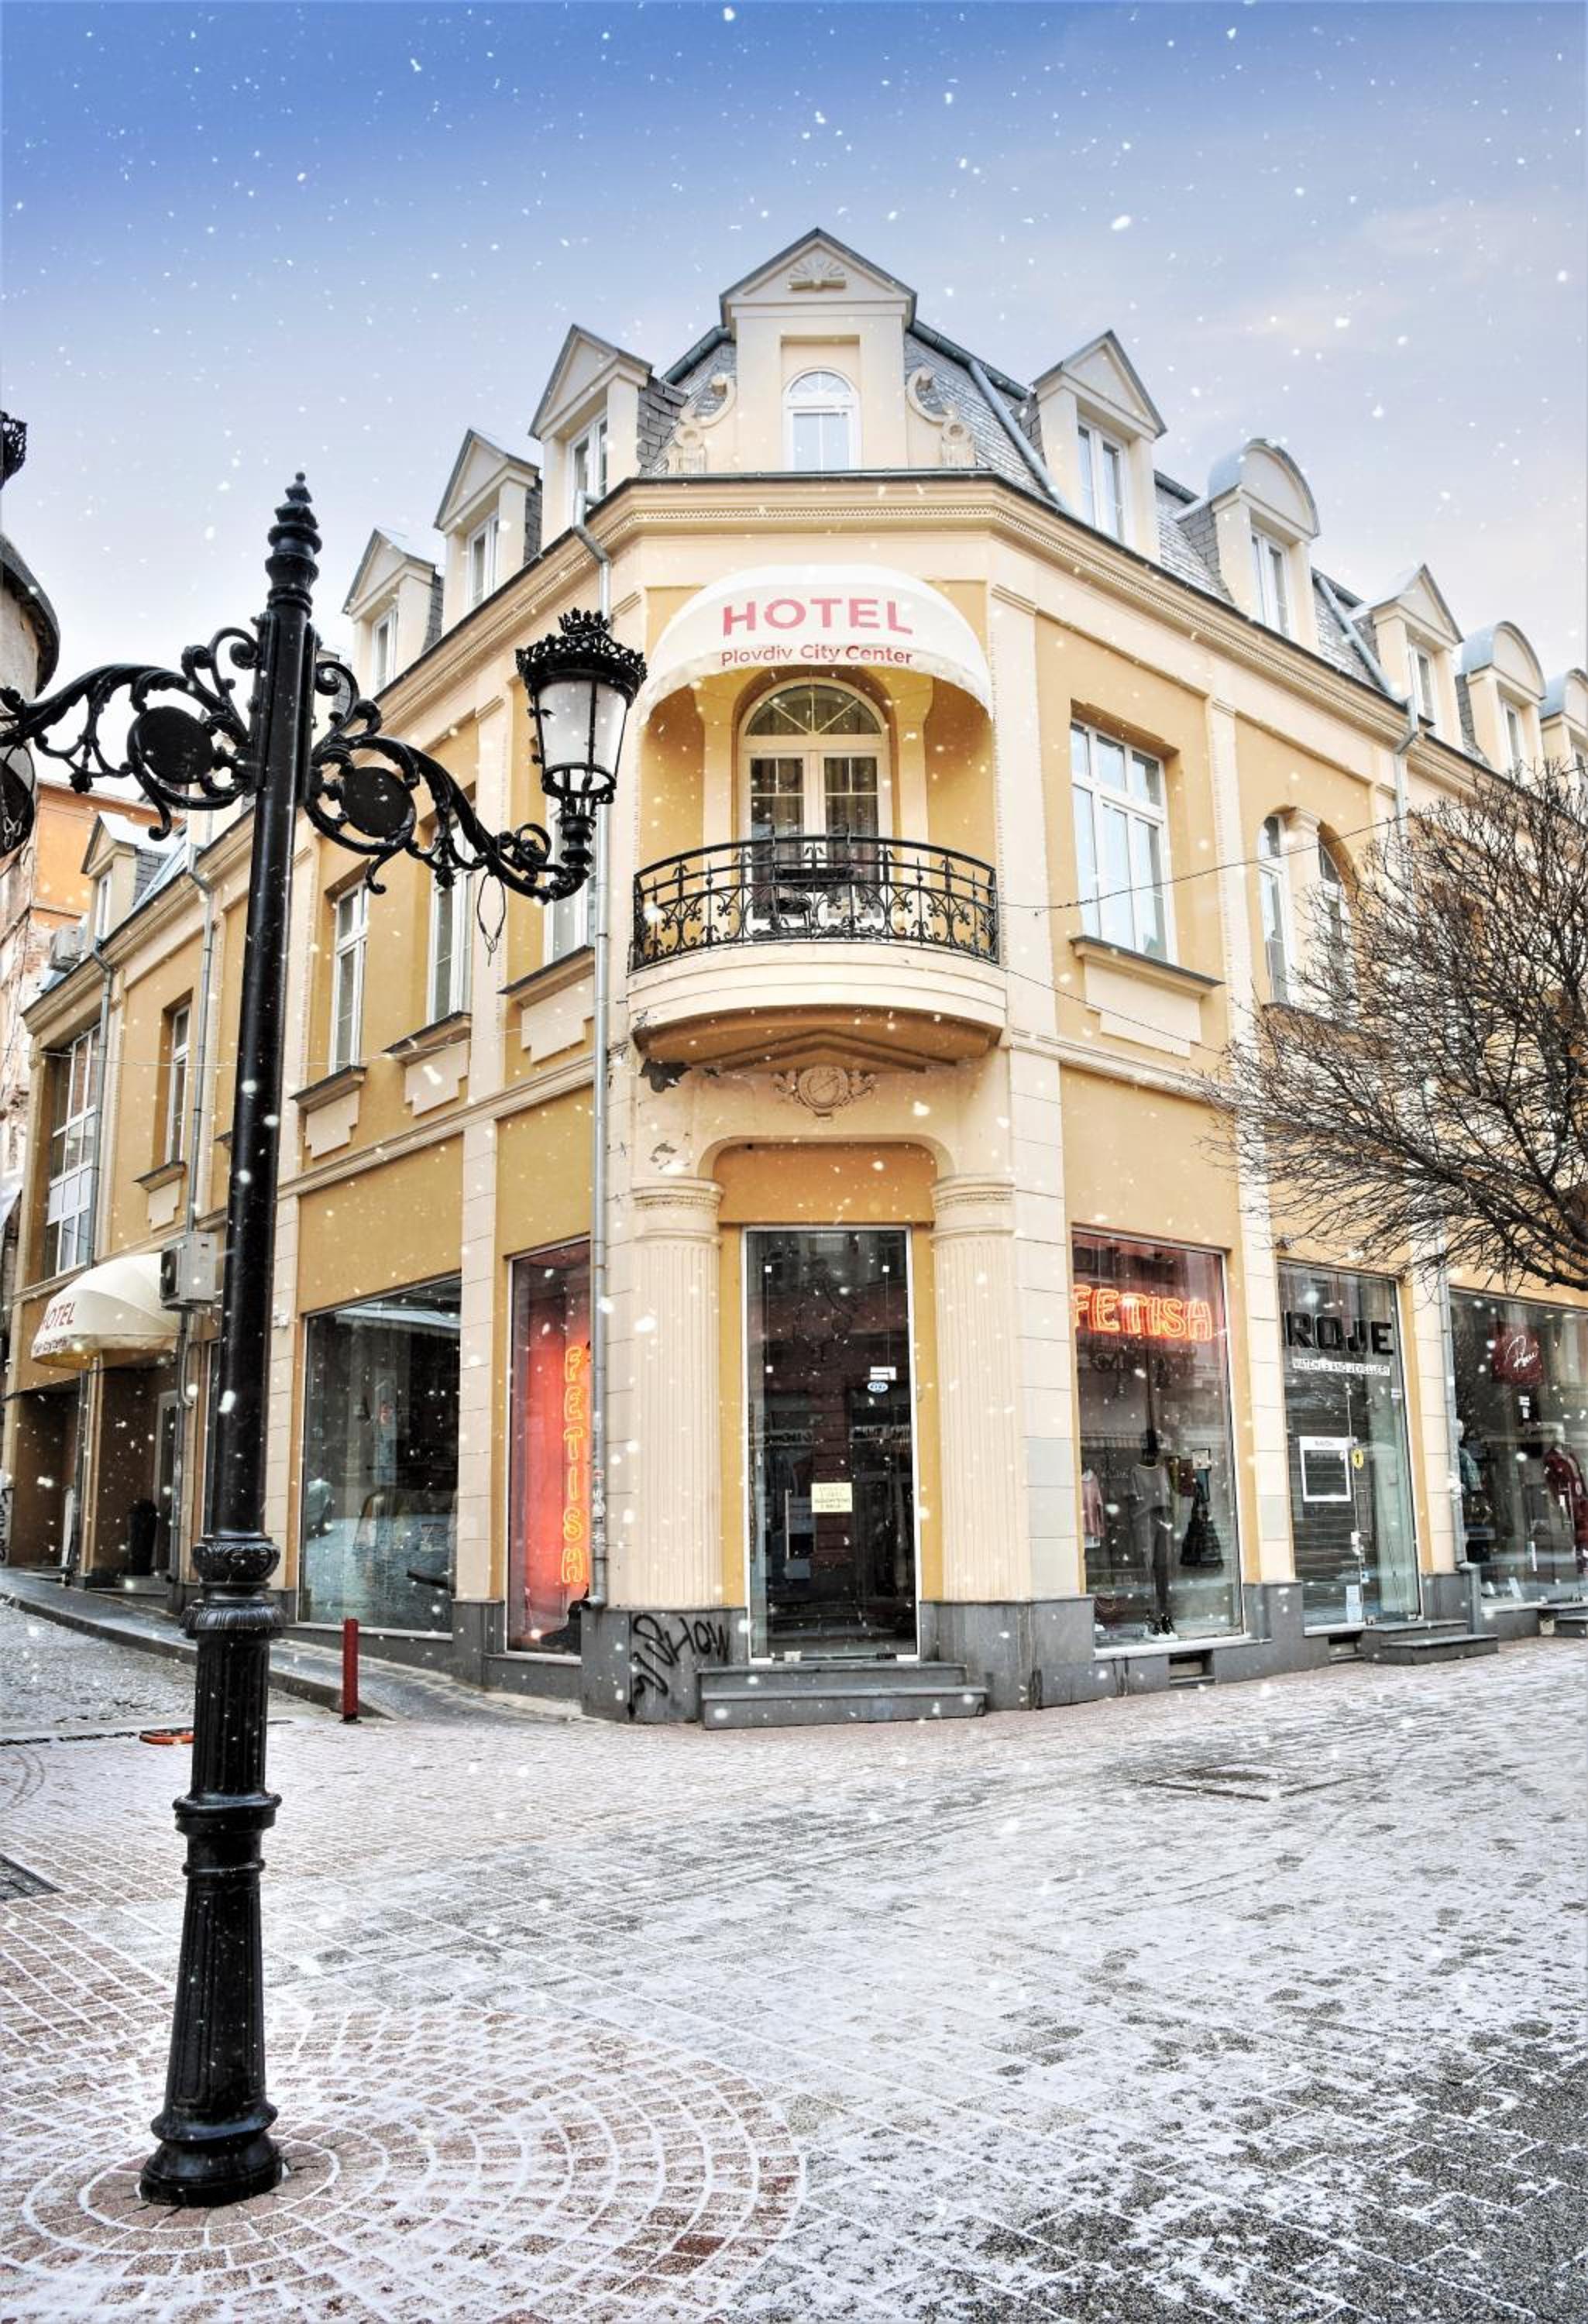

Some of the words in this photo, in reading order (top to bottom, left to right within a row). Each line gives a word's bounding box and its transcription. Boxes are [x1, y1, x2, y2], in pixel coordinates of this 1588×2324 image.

[724, 598, 914, 637] HOTEL
[721, 645, 793, 666] Plovdiv
[800, 644, 840, 662] City
[845, 645, 913, 664] Center
[1072, 1284, 1212, 1341] FETISH
[1283, 1311, 1394, 1355] ROJE
[562, 1346, 583, 1583] FETISH
